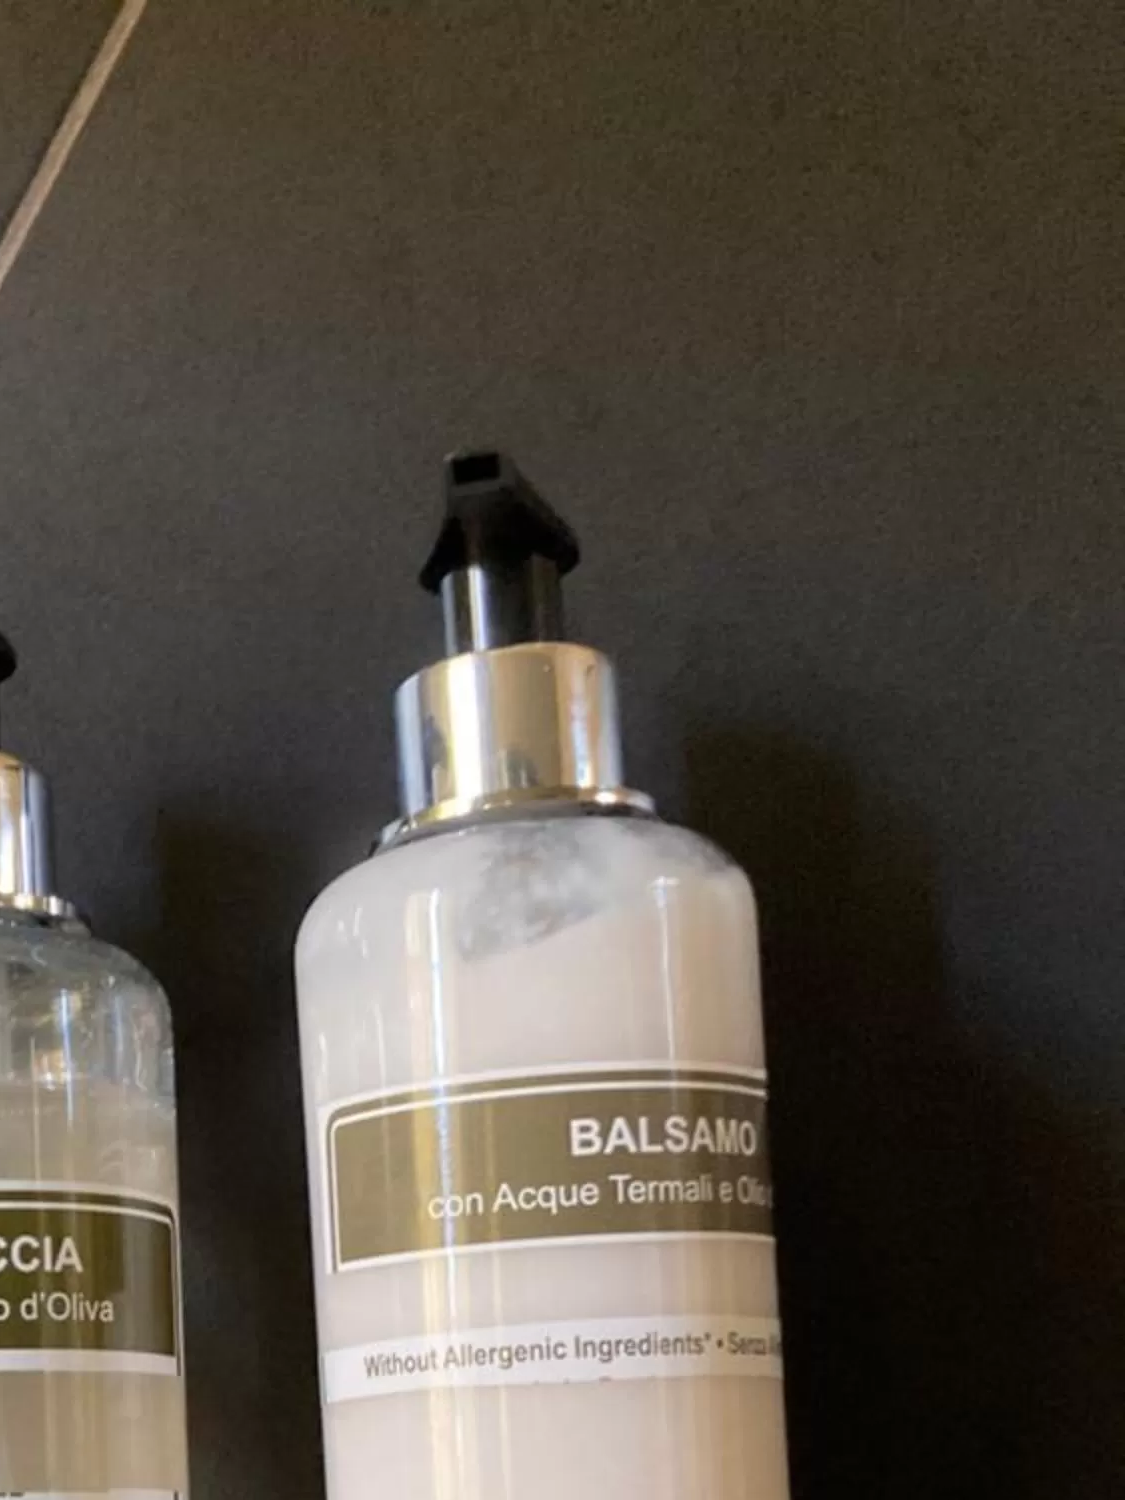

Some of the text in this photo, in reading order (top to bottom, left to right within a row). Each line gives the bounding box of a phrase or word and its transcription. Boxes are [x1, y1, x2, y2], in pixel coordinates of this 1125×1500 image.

[570, 1115, 758, 1157] BALSAMO
[428, 1189, 484, 1220] con
[492, 1181, 601, 1216] Acque
[608, 1173, 714, 1205] Termali
[718, 1181, 734, 1204] e
[19, 1291, 115, 1323] d'Oliva
[363, 1349, 439, 1379] Without
[443, 1335, 568, 1370] Allergenic
